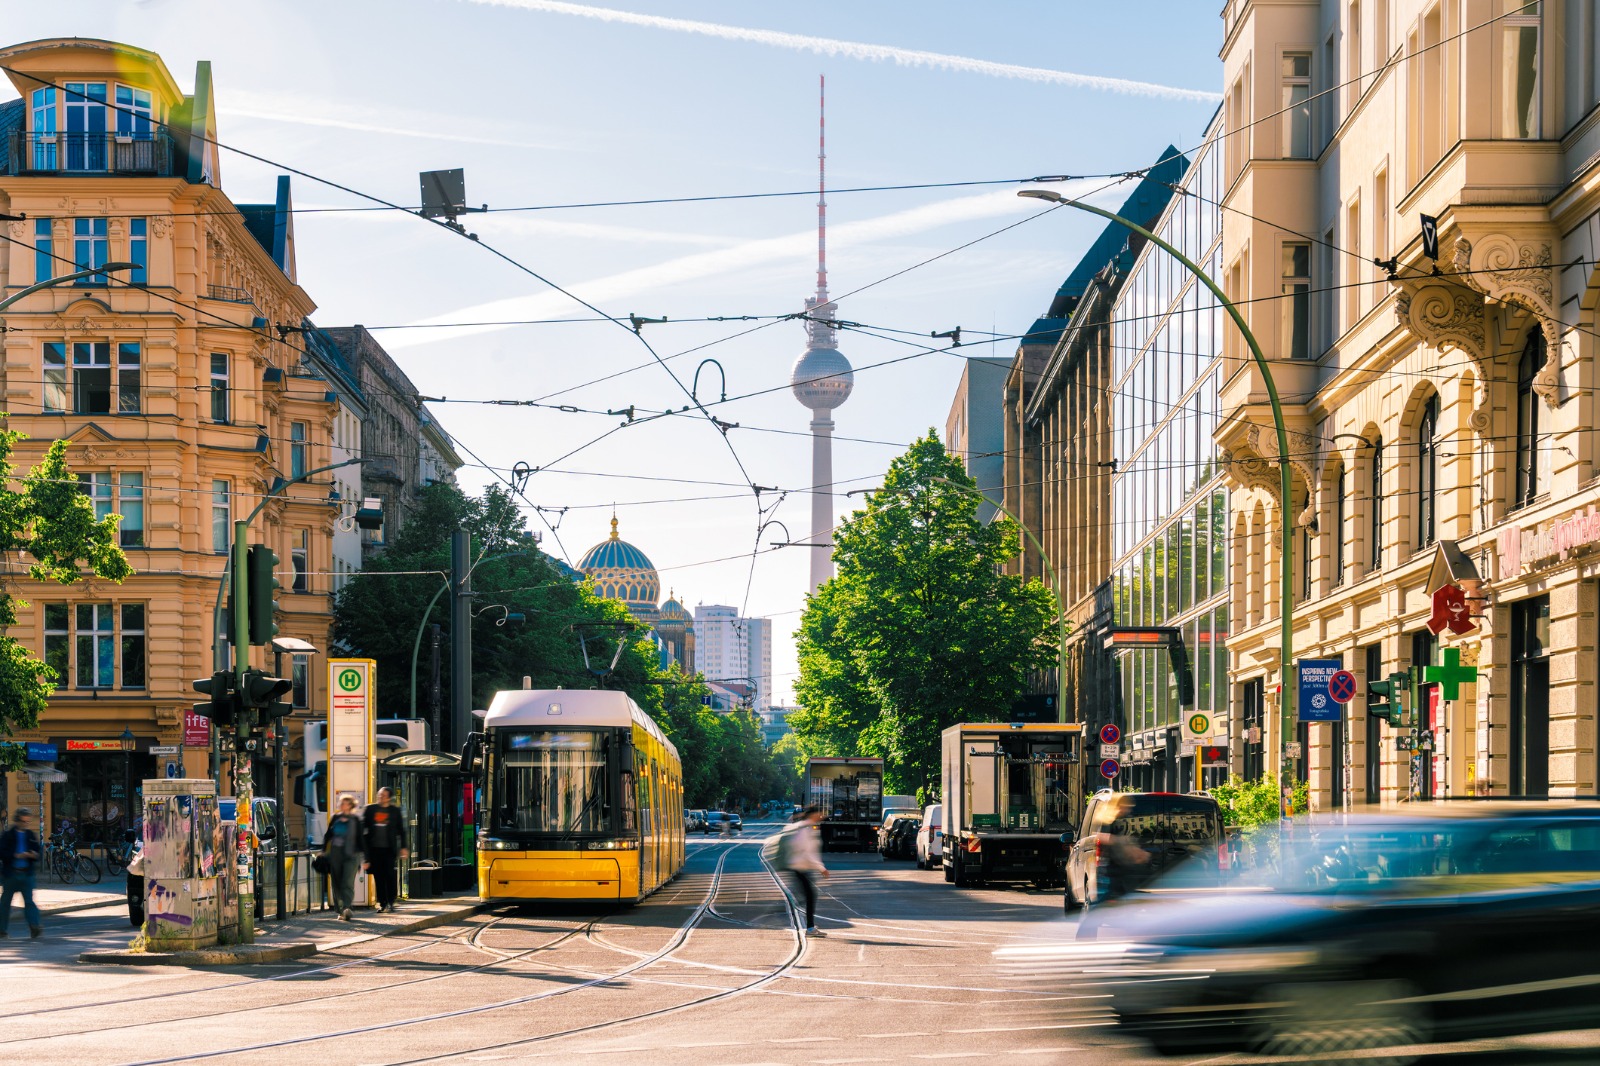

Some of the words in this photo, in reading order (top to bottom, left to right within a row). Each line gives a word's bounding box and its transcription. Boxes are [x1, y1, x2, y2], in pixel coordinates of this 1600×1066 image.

[345, 674, 355, 686] H
[186, 715, 208, 728] ifa
[1194, 719, 1203, 730] H
